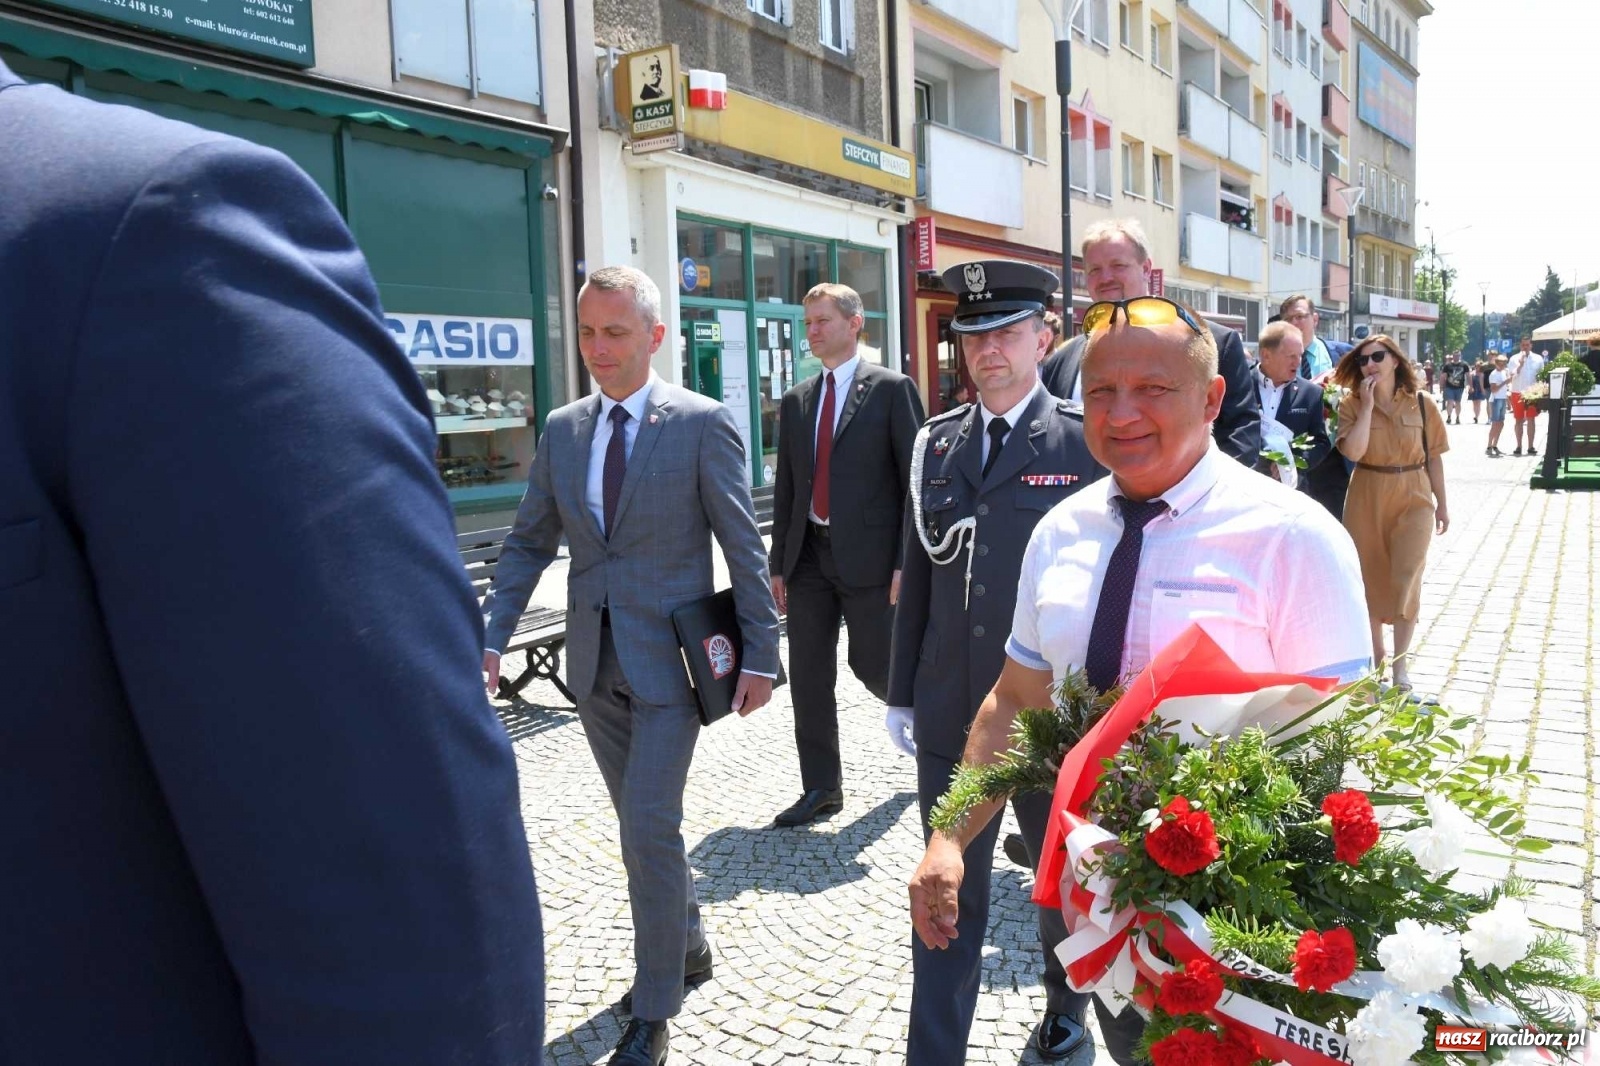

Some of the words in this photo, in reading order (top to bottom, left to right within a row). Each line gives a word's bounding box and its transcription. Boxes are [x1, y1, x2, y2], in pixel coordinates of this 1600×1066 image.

[128, 0, 147, 12] 418
[149, 4, 160, 16] 15
[162, 8, 173, 19] 30
[256, 9, 268, 19] 602
[269, 14, 281, 23] 612
[185, 16, 216, 30] e-mail:
[218, 23, 307, 54] biuro@zientek.com.pl
[646, 103, 671, 117] KASY
[635, 118, 673, 132] STEFCZYKA
[845, 143, 880, 166] STEFCZYK
[918, 221, 930, 266] ŻYWIEC
[1488, 340, 1496, 349] P
[1502, 340, 1510, 350] P
